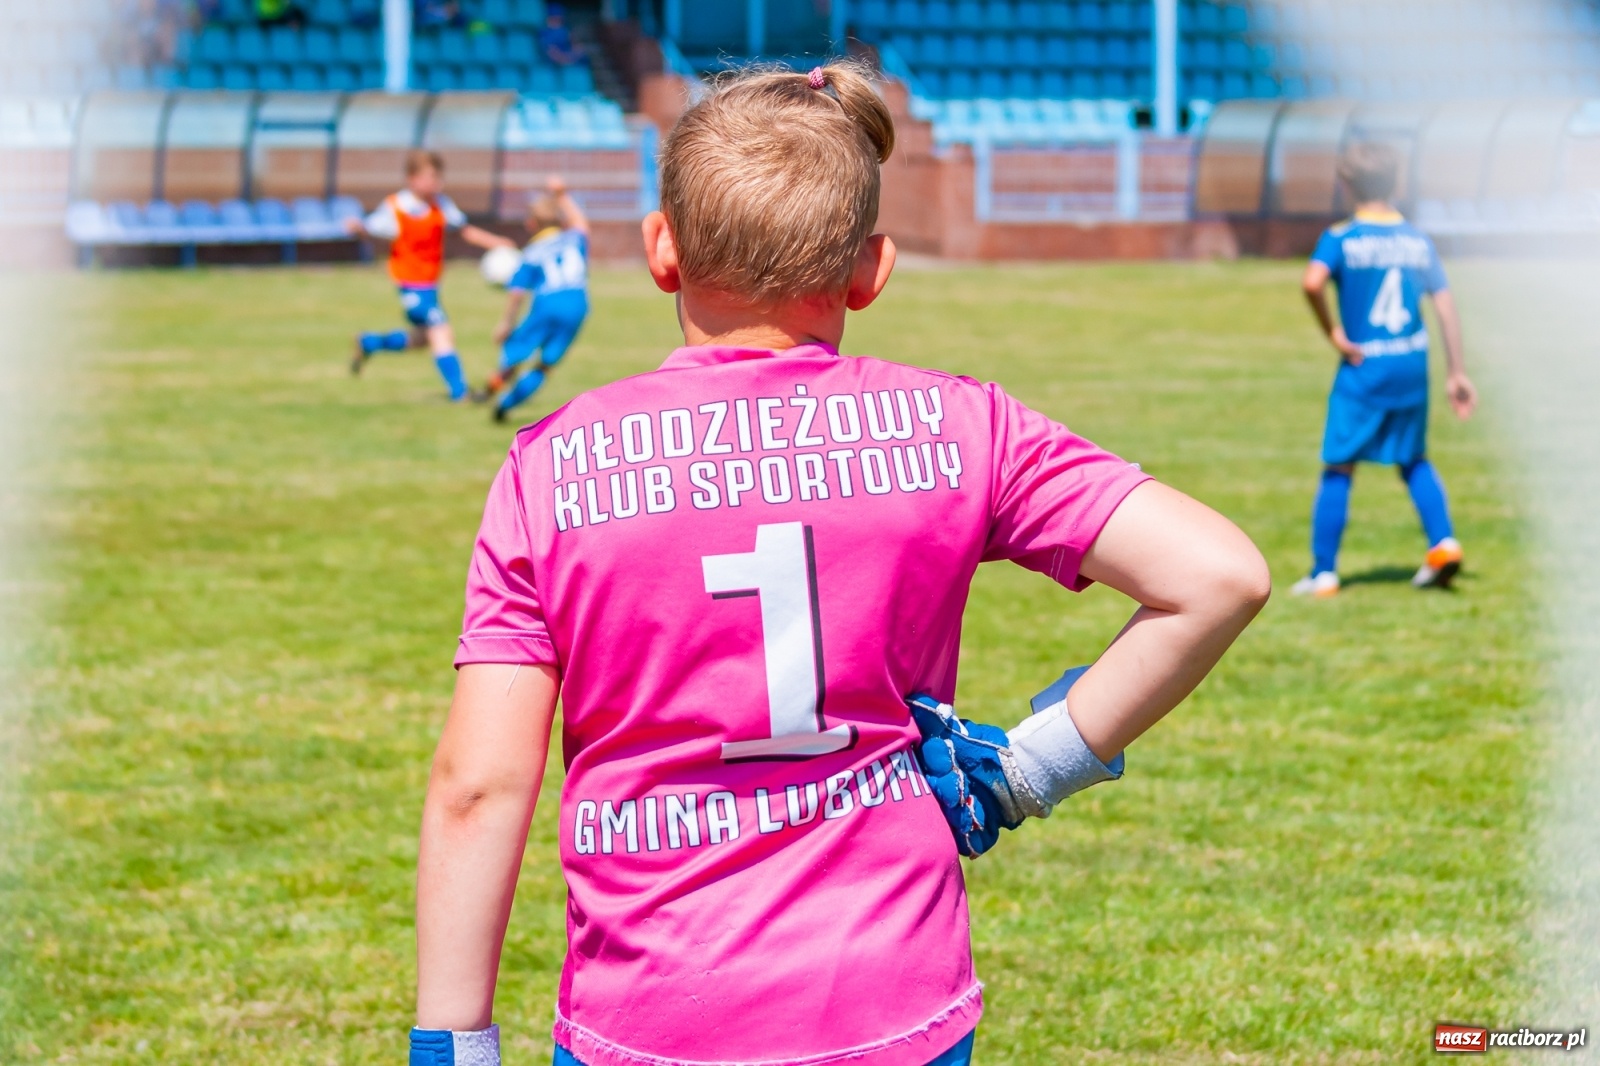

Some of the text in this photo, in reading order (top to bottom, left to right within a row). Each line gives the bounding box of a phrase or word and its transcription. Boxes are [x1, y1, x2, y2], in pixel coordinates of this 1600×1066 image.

[1369, 268, 1411, 334] 4
[550, 384, 944, 482] MŁODZIEŻOWY
[553, 441, 963, 532] KLUB SPORTOWY
[701, 521, 859, 763] 1
[574, 791, 740, 855] GMINA
